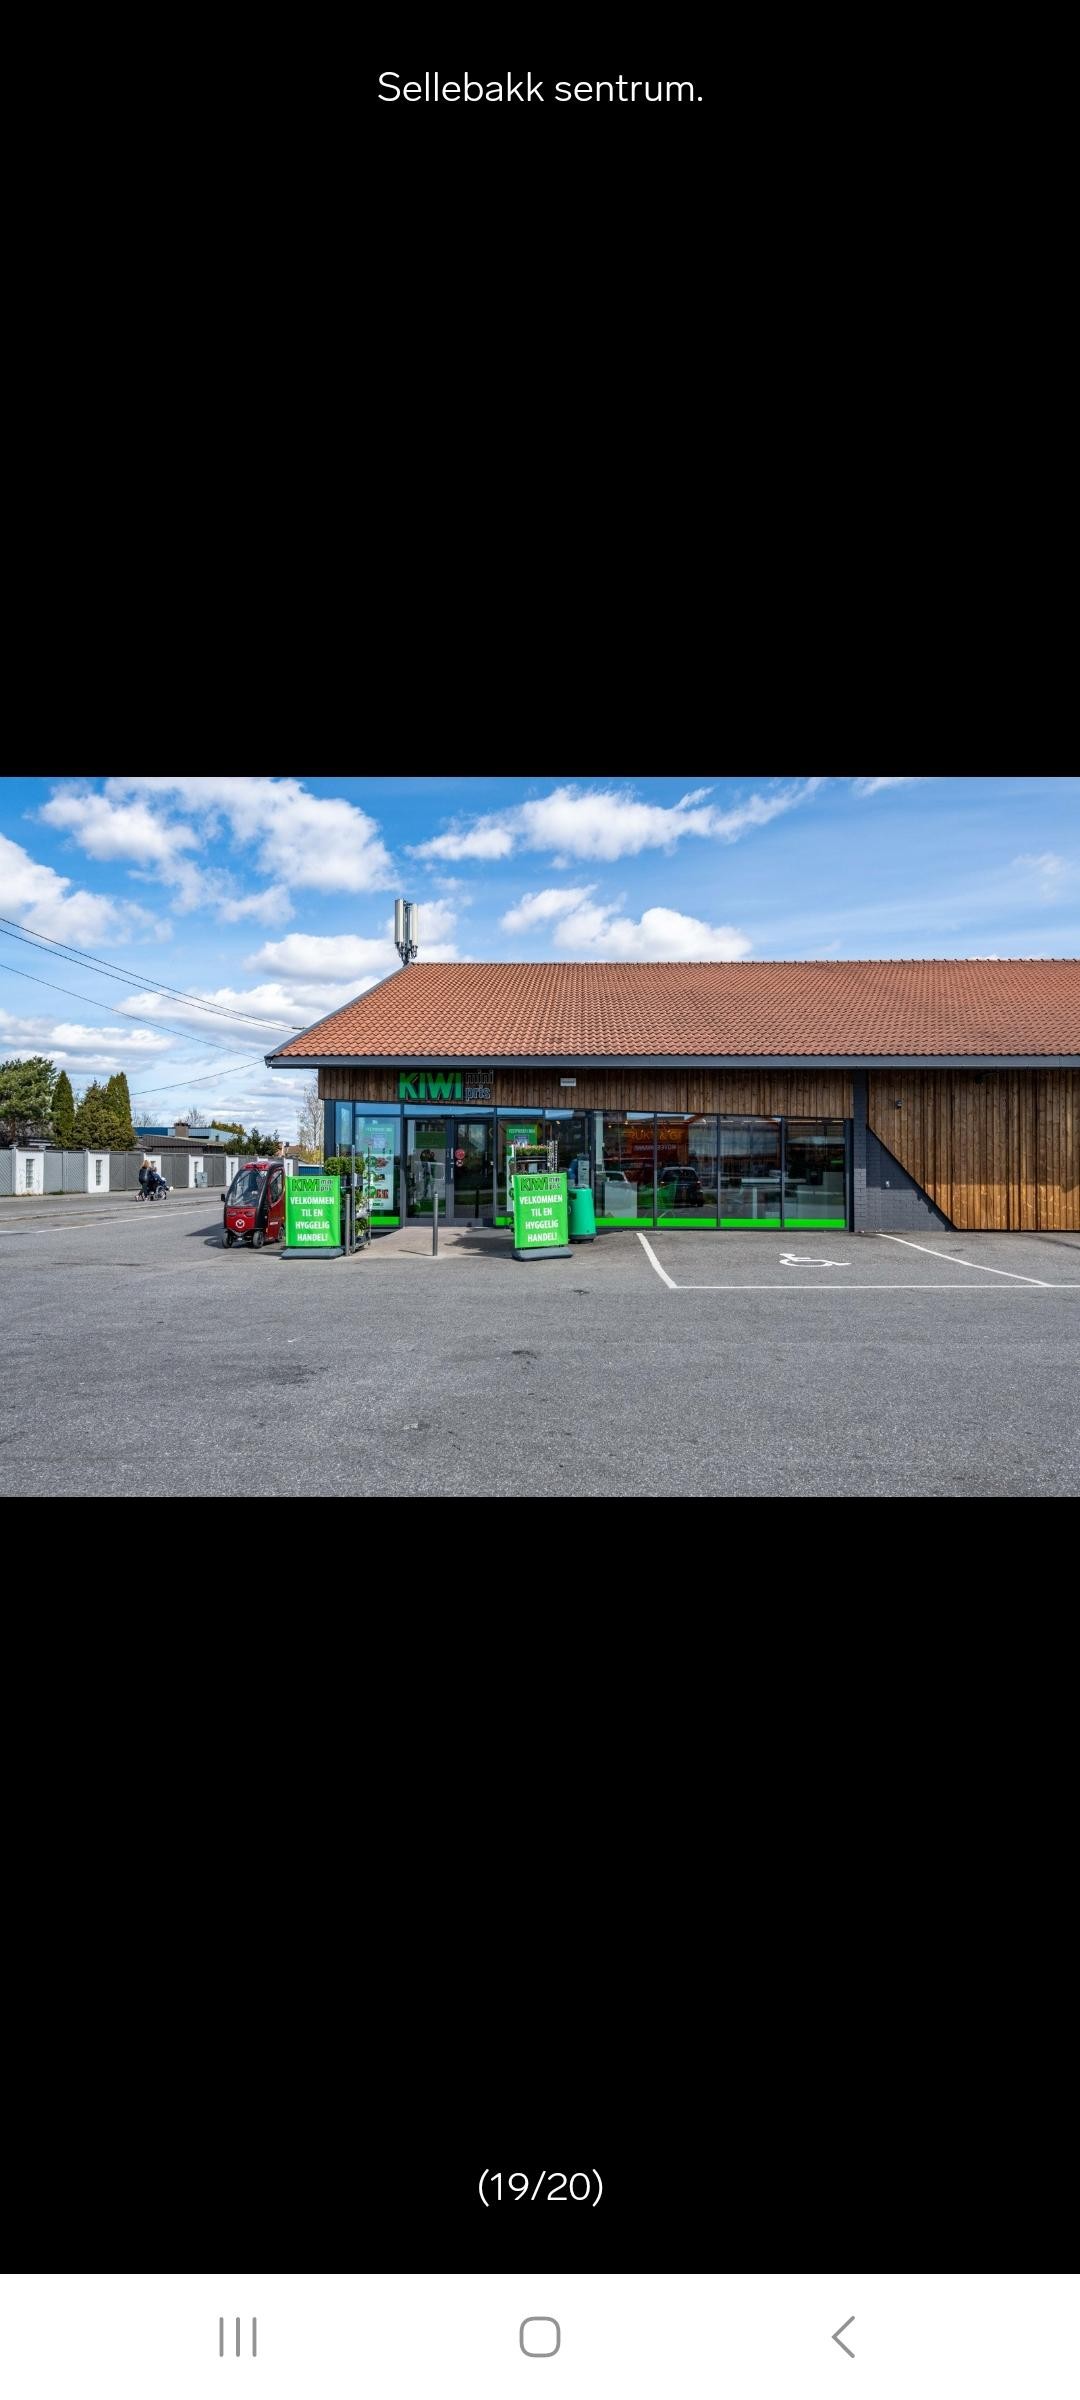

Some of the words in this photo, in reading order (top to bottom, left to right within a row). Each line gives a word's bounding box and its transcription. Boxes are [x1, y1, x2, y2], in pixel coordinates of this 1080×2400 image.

[399, 1072, 462, 1100] KIWI
[465, 1070, 494, 1084] mini
[465, 1085, 491, 1101] pris
[291, 1179, 320, 1191] KIWI
[520, 1177, 548, 1191] KIWI
[290, 1197, 334, 1205] VELKOMMEN
[519, 1194, 562, 1204] VELKOMMEN
[531, 1208, 541, 1217] TIL
[543, 1207, 552, 1215] EN
[295, 1221, 330, 1229] HYGGELIG
[525, 1220, 558, 1229] HYGGELIG
[297, 1233, 327, 1241] HANDEL!
[527, 1233, 557, 1242] HANDEL!
